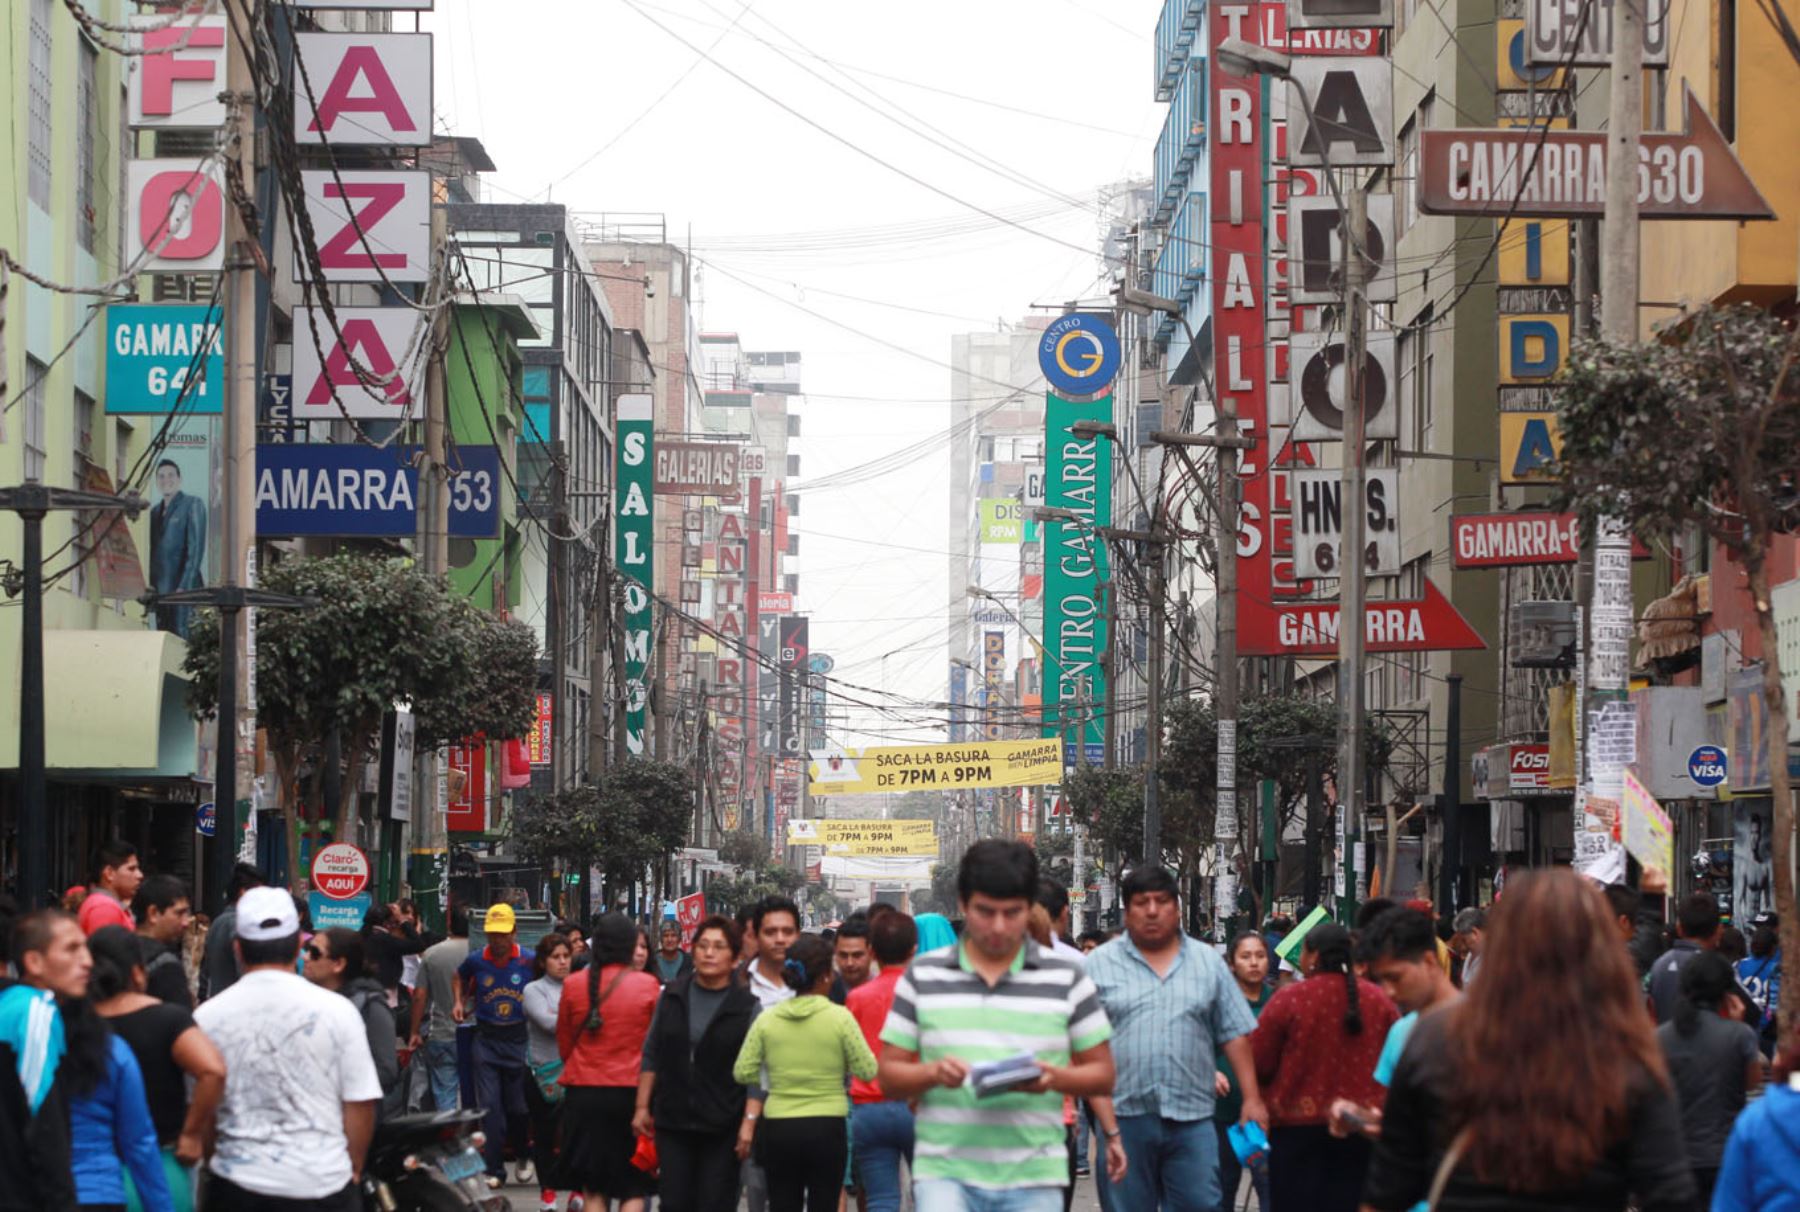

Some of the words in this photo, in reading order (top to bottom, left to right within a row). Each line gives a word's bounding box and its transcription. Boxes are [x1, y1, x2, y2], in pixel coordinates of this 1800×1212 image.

[1534, 0, 1666, 54] CENTO
[1044, 318, 1080, 352] CENTRO
[656, 450, 735, 486] GALERIAS
[447, 469, 492, 513] 53
[1060, 420, 1097, 578] GAMARR
[1314, 541, 1380, 574] 64
[1279, 608, 1425, 646] GAMRRA
[876, 754, 912, 767] SACA
[916, 752, 932, 765] LA
[936, 750, 990, 764] BASURA
[1007, 744, 1058, 762] GAMARRA
[877, 773, 895, 786] DE
[899, 768, 936, 785] 7PM
[940, 771, 950, 783] A
[953, 765, 992, 782] 9PM
[1692, 765, 1724, 778] VISA
[840, 832, 861, 841] 7PM
[871, 832, 893, 841] 9PM
[323, 853, 353, 865] Claro
